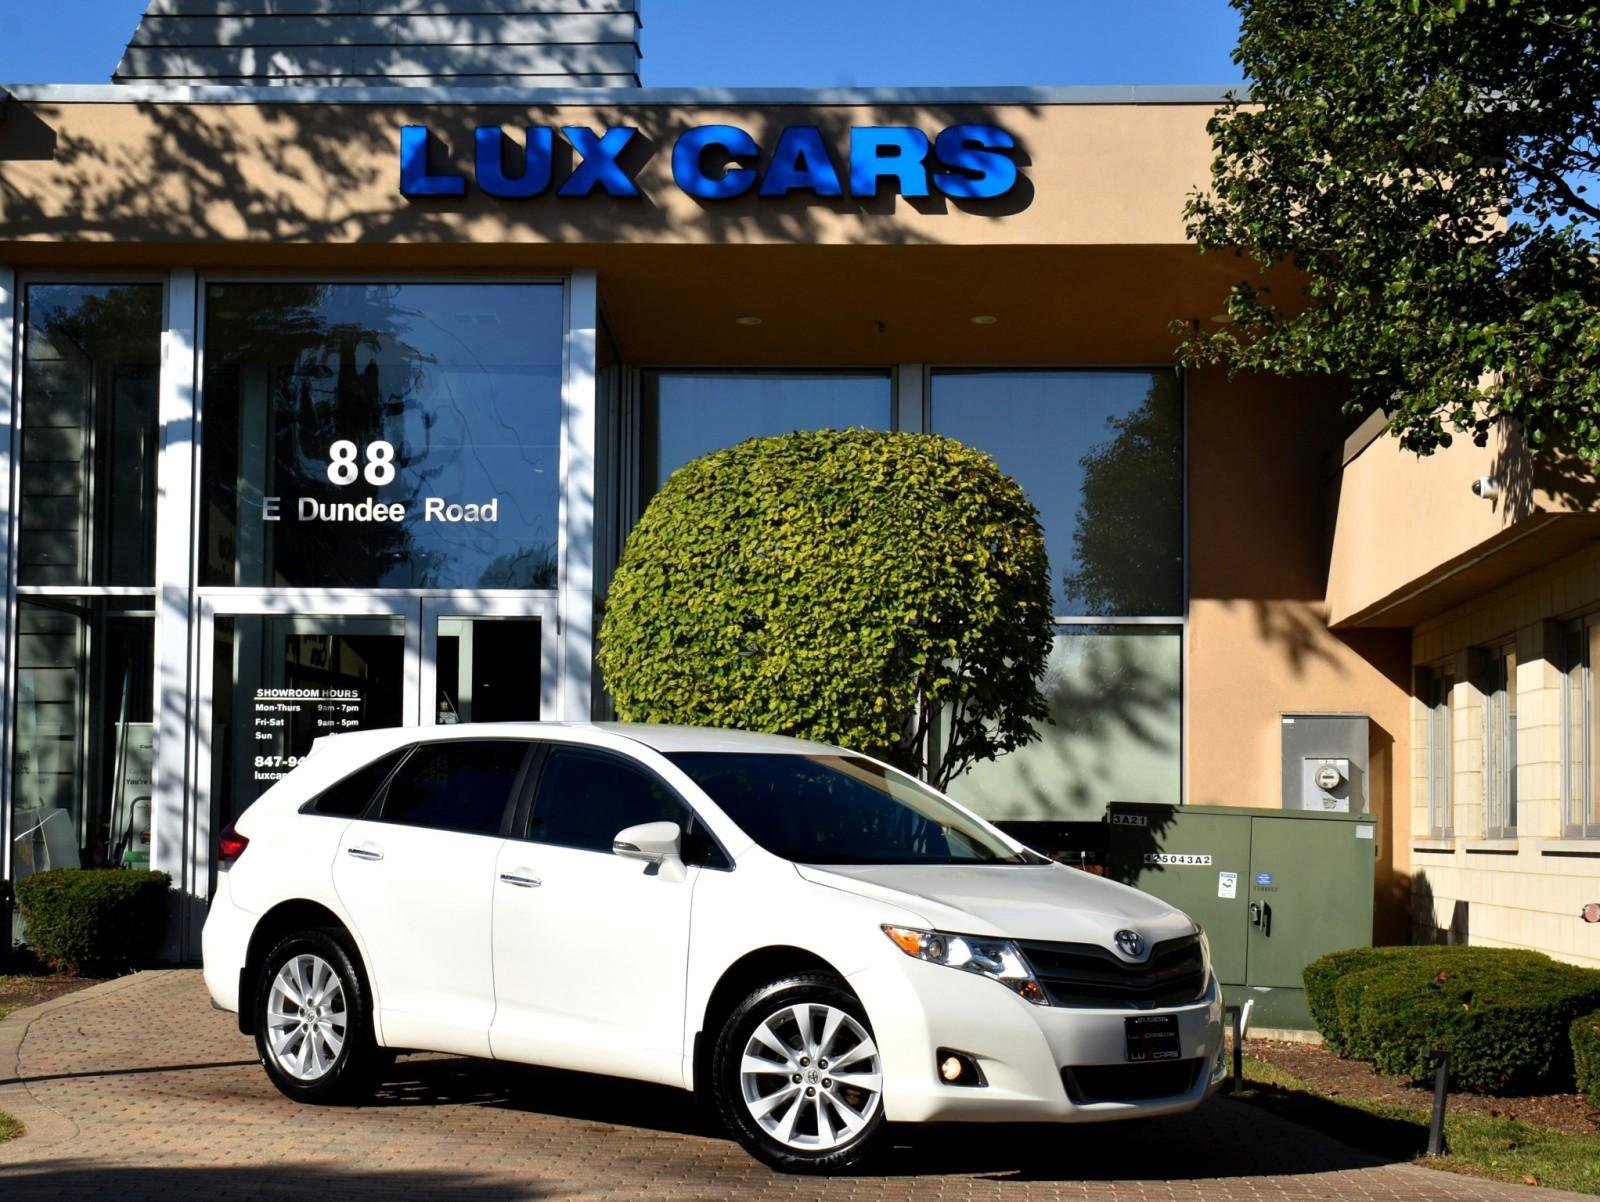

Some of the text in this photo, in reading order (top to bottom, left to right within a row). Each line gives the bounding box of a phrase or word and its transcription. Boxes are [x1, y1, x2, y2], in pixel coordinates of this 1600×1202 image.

[400, 124, 1017, 198] LUX CARS
[327, 440, 396, 486] 88
[262, 497, 498, 522] E Dundee Road
[256, 688, 359, 697] SHOWROOM HOURS
[255, 704, 301, 712] Mon-Thurs
[341, 704, 359, 713] 7pm
[255, 718, 284, 727] Fri-Sat
[317, 719, 335, 727] 9am
[341, 718, 359, 728] 5pm
[255, 731, 273, 740] Sun
[1113, 815, 1147, 825] 3A21
[1144, 854, 1211, 865] 425043A2
